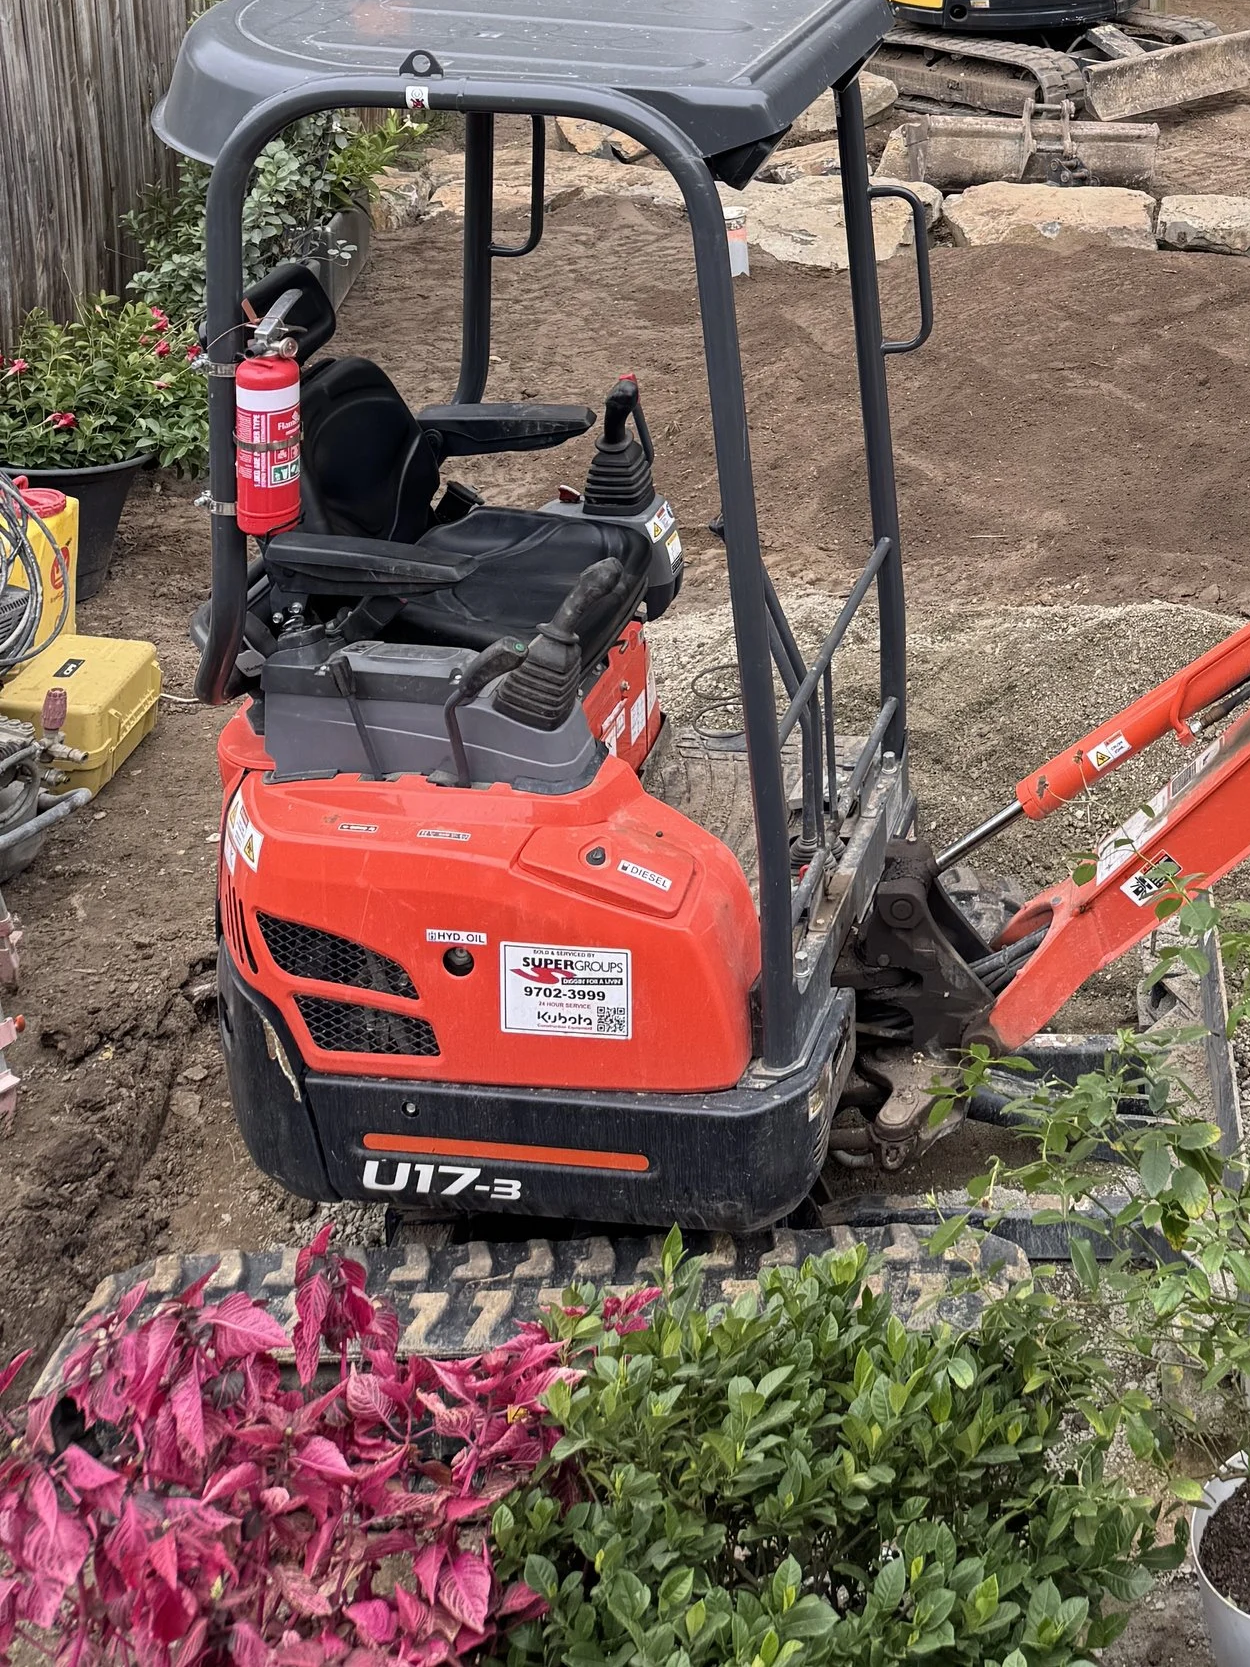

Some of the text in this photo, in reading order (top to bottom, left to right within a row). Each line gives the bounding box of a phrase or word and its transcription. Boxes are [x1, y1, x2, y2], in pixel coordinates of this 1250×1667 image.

[630, 866, 667, 888] DIESEL
[437, 932, 485, 943] HYD. OIL
[522, 956, 623, 974] SUPERGROUPS
[524, 986, 606, 1001] 9702-3999
[565, 1002, 592, 1010] SERVICE
[537, 1011, 593, 1026] Kubota
[362, 1160, 522, 1201] U17-3
